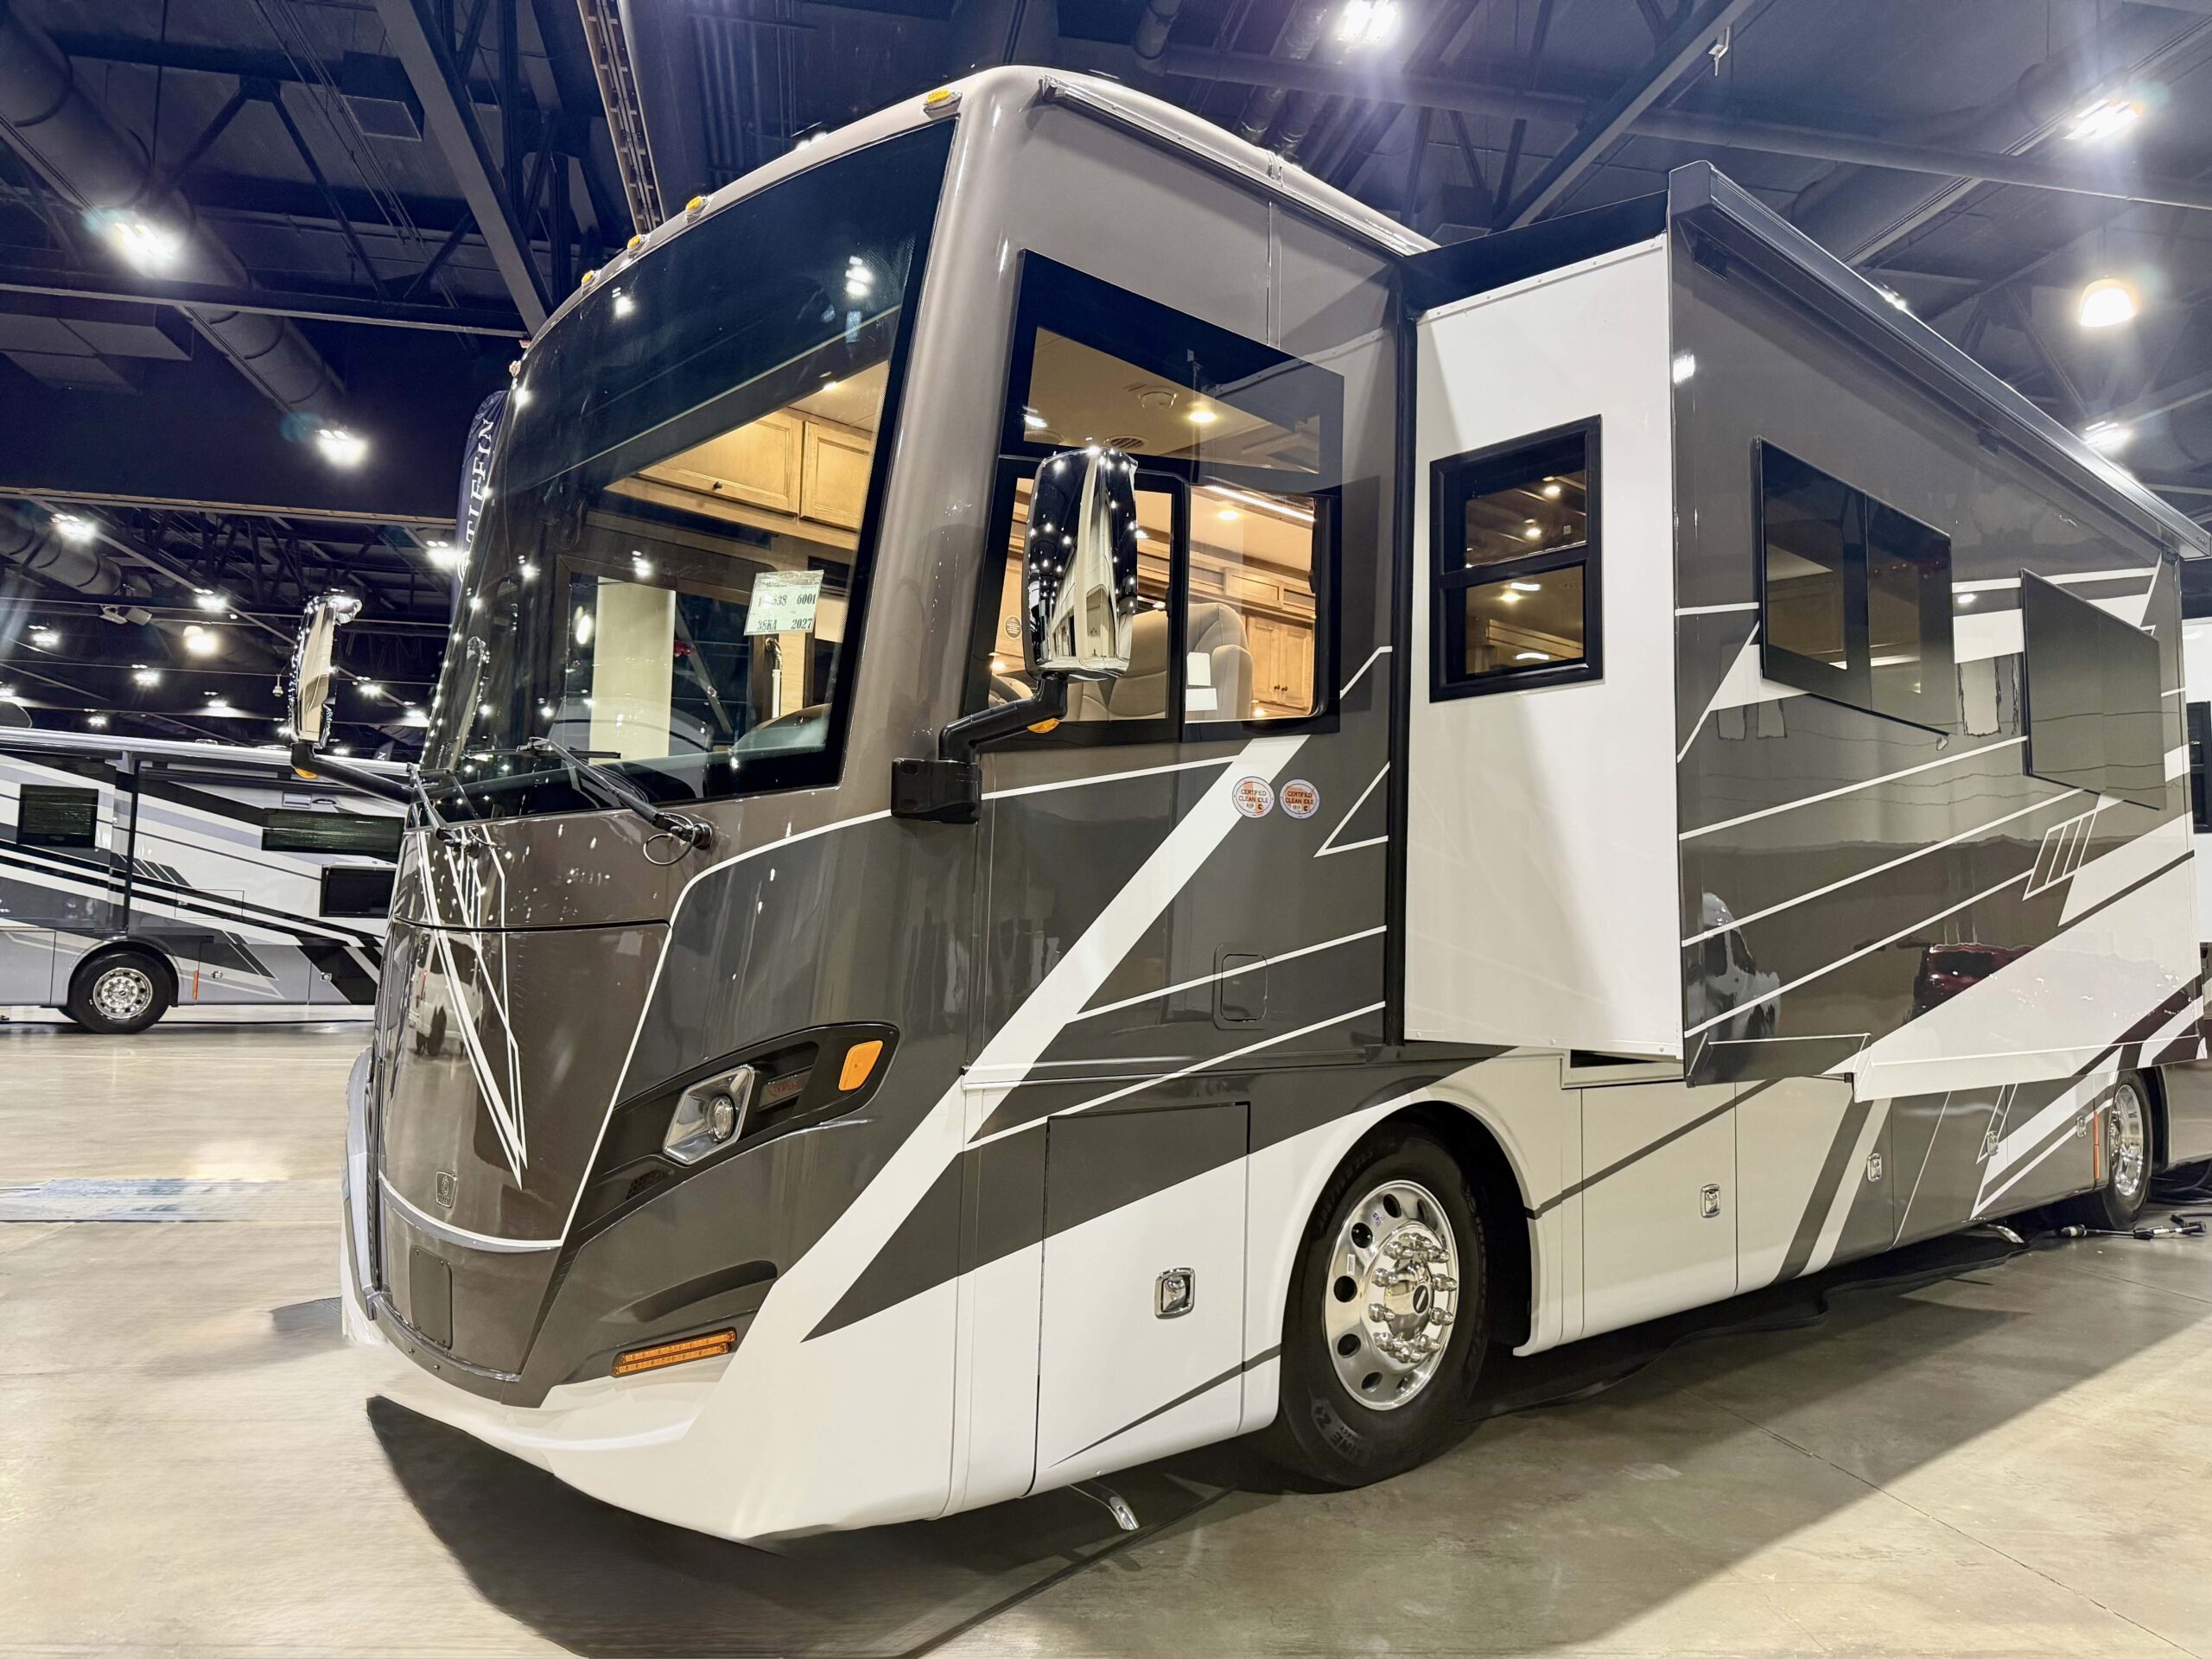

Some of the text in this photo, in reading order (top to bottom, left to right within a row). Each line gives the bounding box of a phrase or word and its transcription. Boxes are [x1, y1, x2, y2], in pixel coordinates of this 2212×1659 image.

[465, 418, 494, 543] TIFFIN
[797, 594, 817, 605] 6001
[791, 618, 813, 630] 2027
